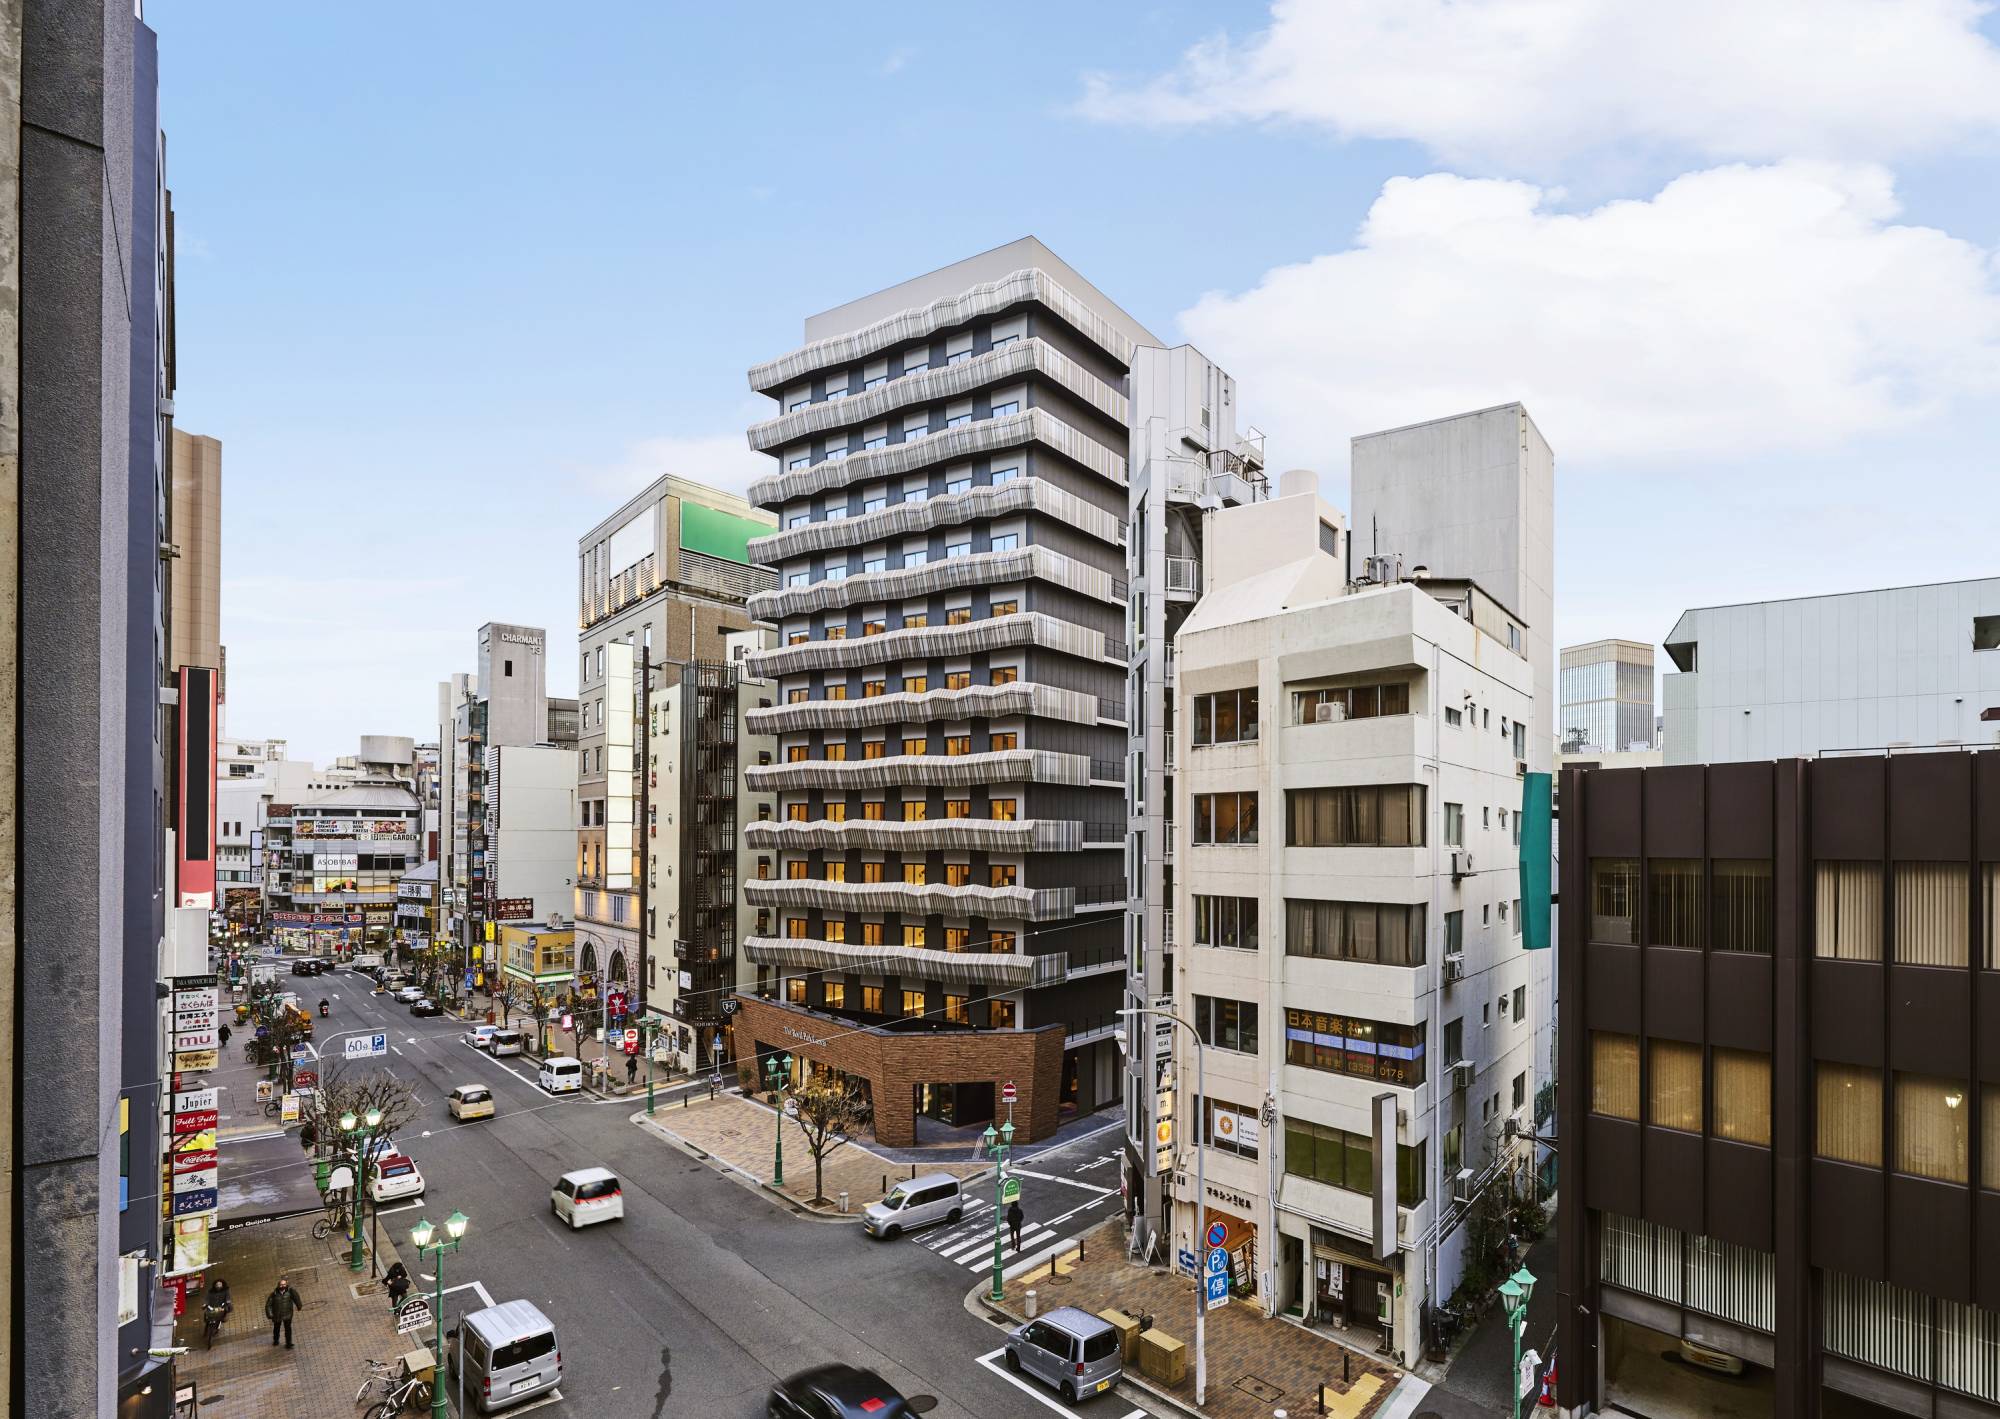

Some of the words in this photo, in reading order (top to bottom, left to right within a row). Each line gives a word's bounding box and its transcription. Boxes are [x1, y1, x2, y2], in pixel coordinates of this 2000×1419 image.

[502, 633, 543, 645] CHARMANT
[180, 1000, 214, 1009] さくらんぼ
[179, 1035, 211, 1047] mu
[374, 1036, 382, 1045] P
[1380, 1067, 1404, 1079] 0178
[181, 1096, 212, 1110] Jupier
[245, 1218, 271, 1227] Quijote
[1211, 1254, 1220, 1271] P
[1210, 1277, 1225, 1295] 停
